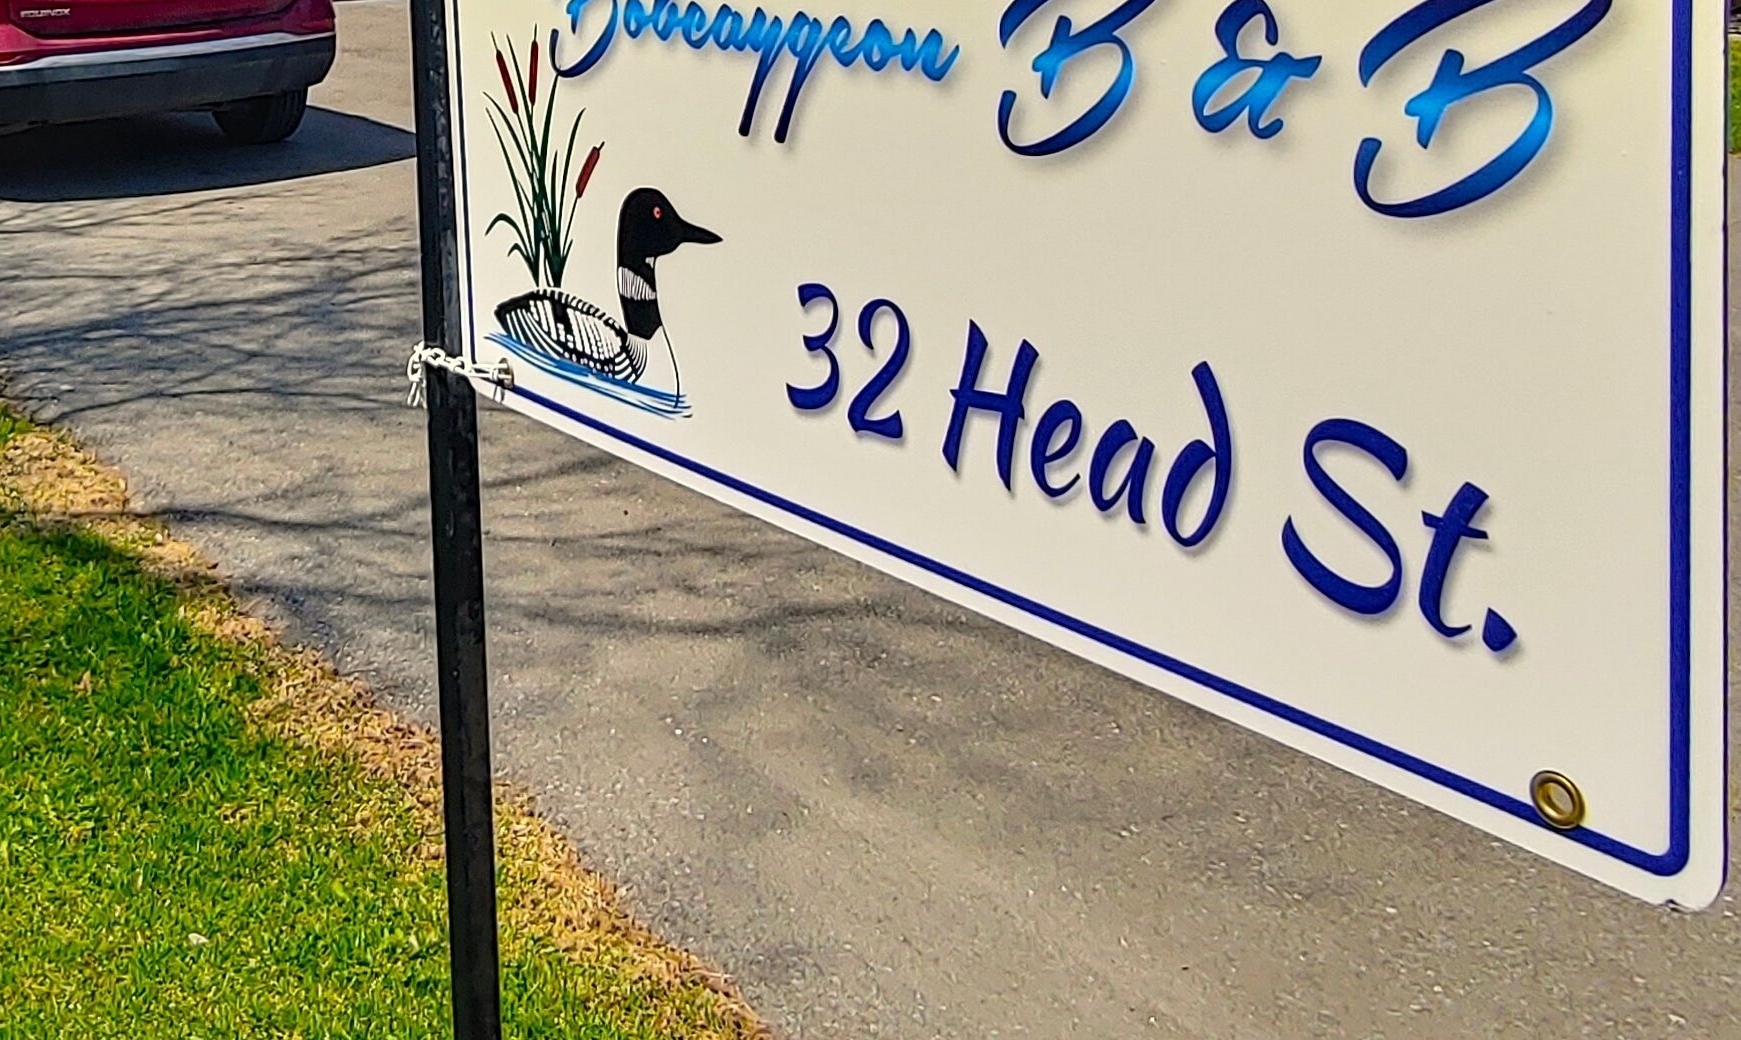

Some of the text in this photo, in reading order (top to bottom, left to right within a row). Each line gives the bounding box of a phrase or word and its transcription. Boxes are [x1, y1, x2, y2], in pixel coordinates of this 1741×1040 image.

[785, 283, 1518, 653] 32 Head St.
